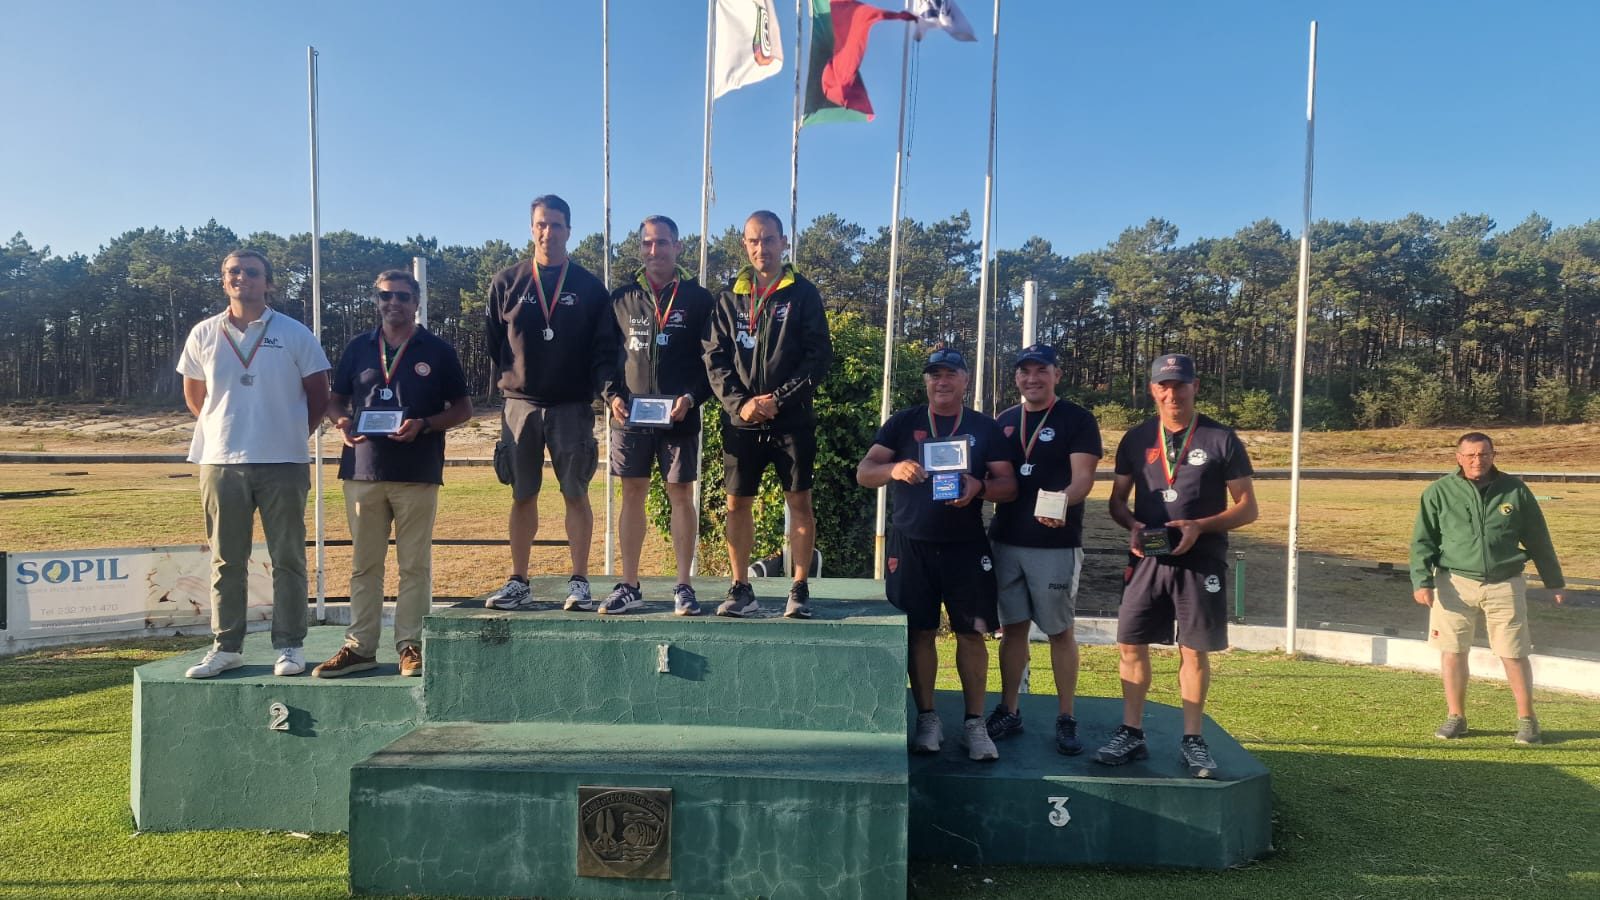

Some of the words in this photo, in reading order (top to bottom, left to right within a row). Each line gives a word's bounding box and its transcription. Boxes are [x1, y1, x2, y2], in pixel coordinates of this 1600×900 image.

[15, 558, 129, 585] SOPIL
[270, 702, 290, 730] 2
[1047, 796, 1071, 827] 3
